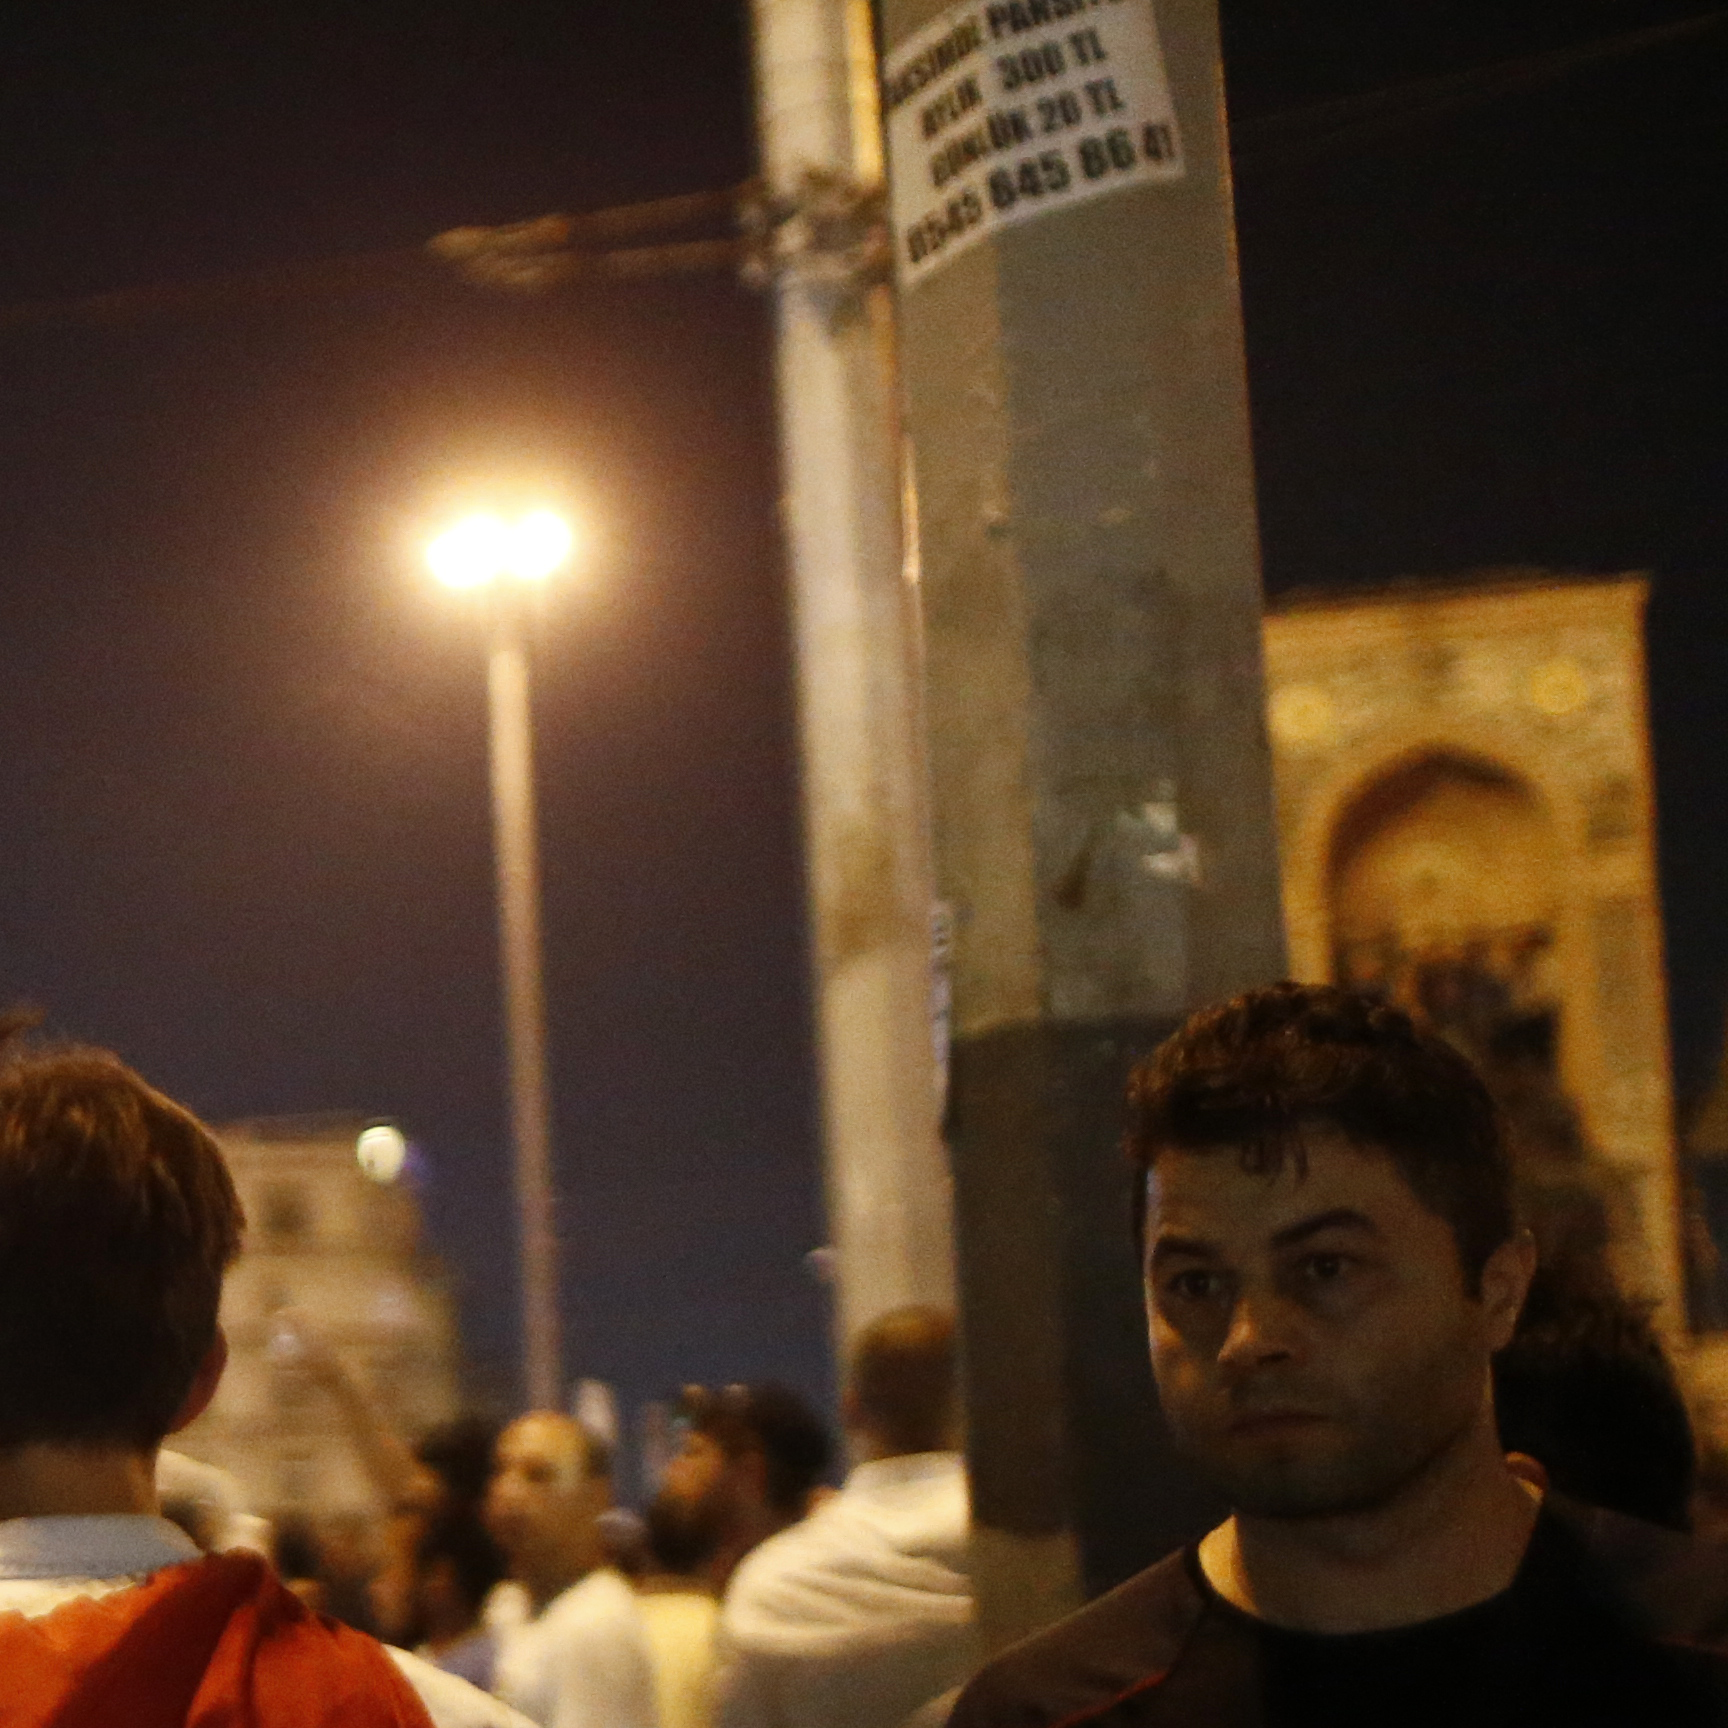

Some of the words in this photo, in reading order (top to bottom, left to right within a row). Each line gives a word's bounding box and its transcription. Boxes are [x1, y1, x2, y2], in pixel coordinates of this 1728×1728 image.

[997, 41, 1064, 91] 300
[1068, 27, 1107, 65] TL
[1037, 90, 1082, 133] 20
[1084, 76, 1124, 116] TL
